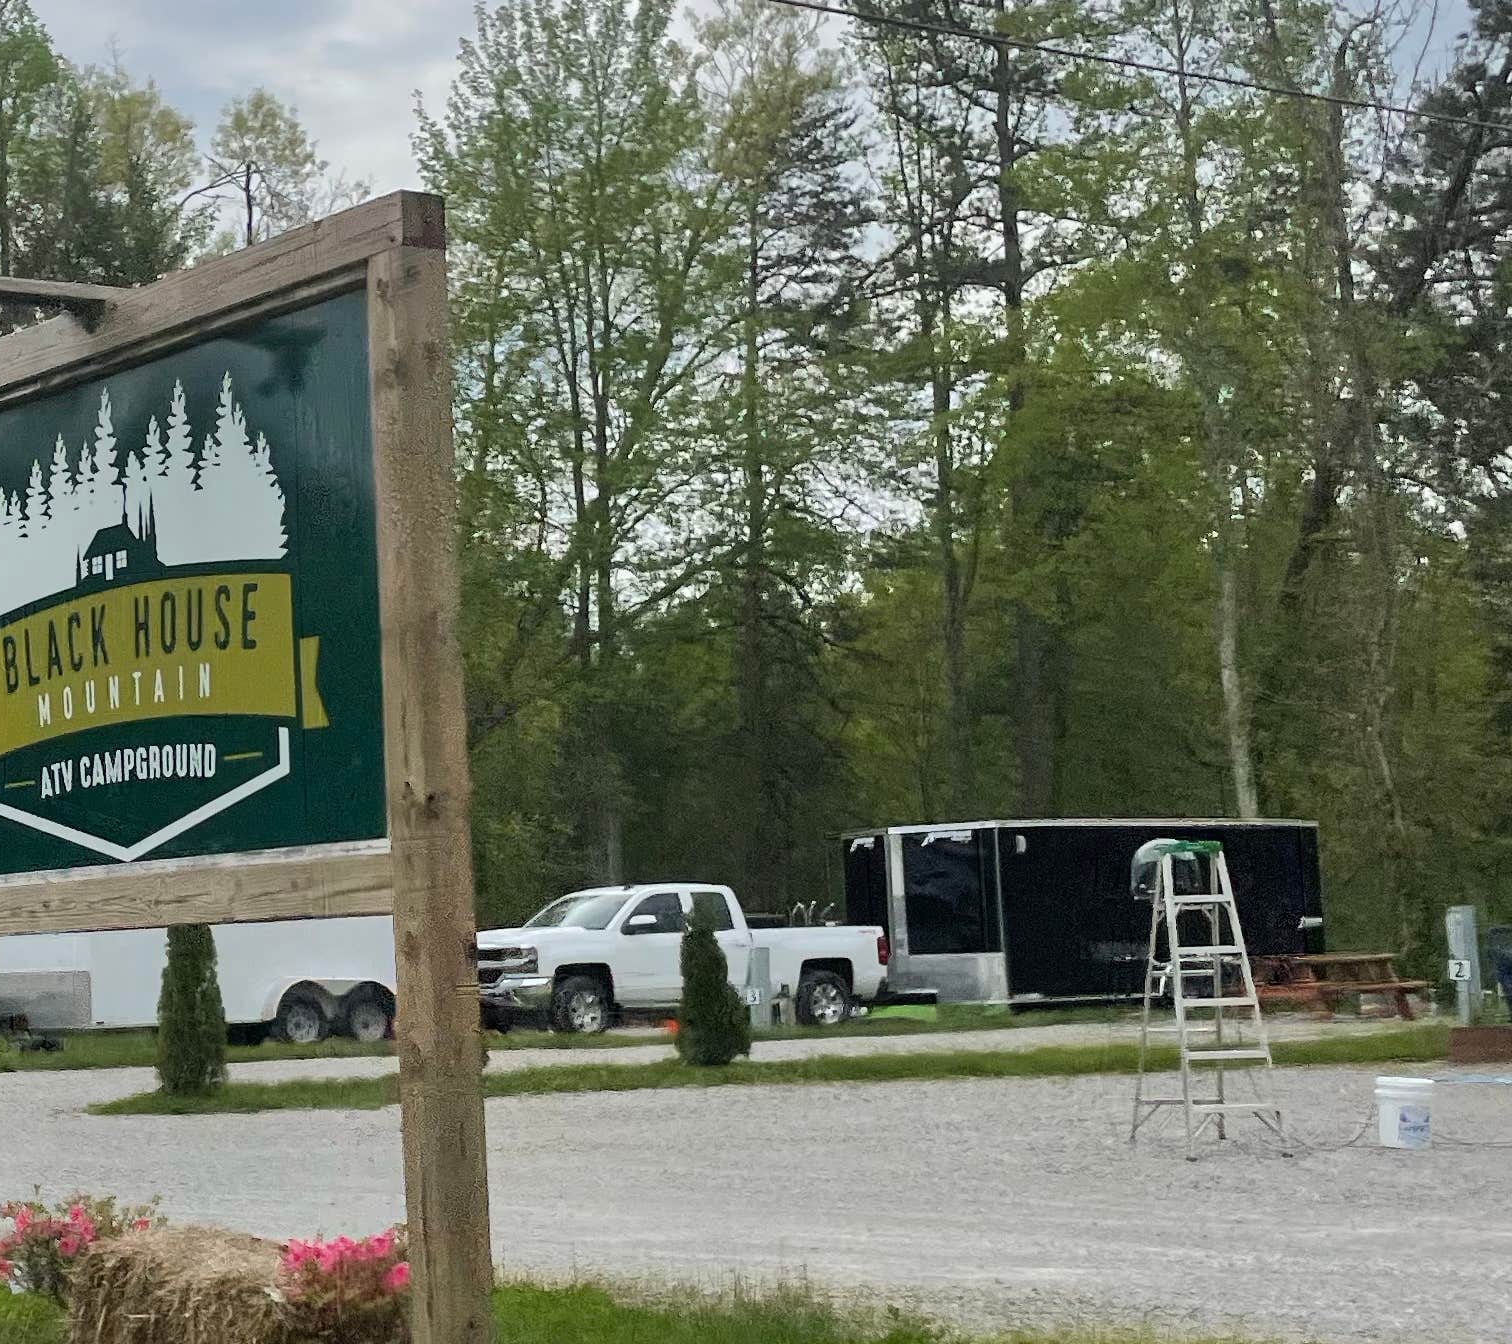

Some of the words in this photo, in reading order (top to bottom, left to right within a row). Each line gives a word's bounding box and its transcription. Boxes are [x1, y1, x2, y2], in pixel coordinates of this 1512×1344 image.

[3, 604, 109, 694] BLACK
[135, 583, 258, 658] HOUSE
[38, 663, 211, 727] MOUNTAIN
[40, 759, 74, 799] ATV
[80, 743, 216, 789] CAMPGROUND
[1454, 961, 1465, 978] 2
